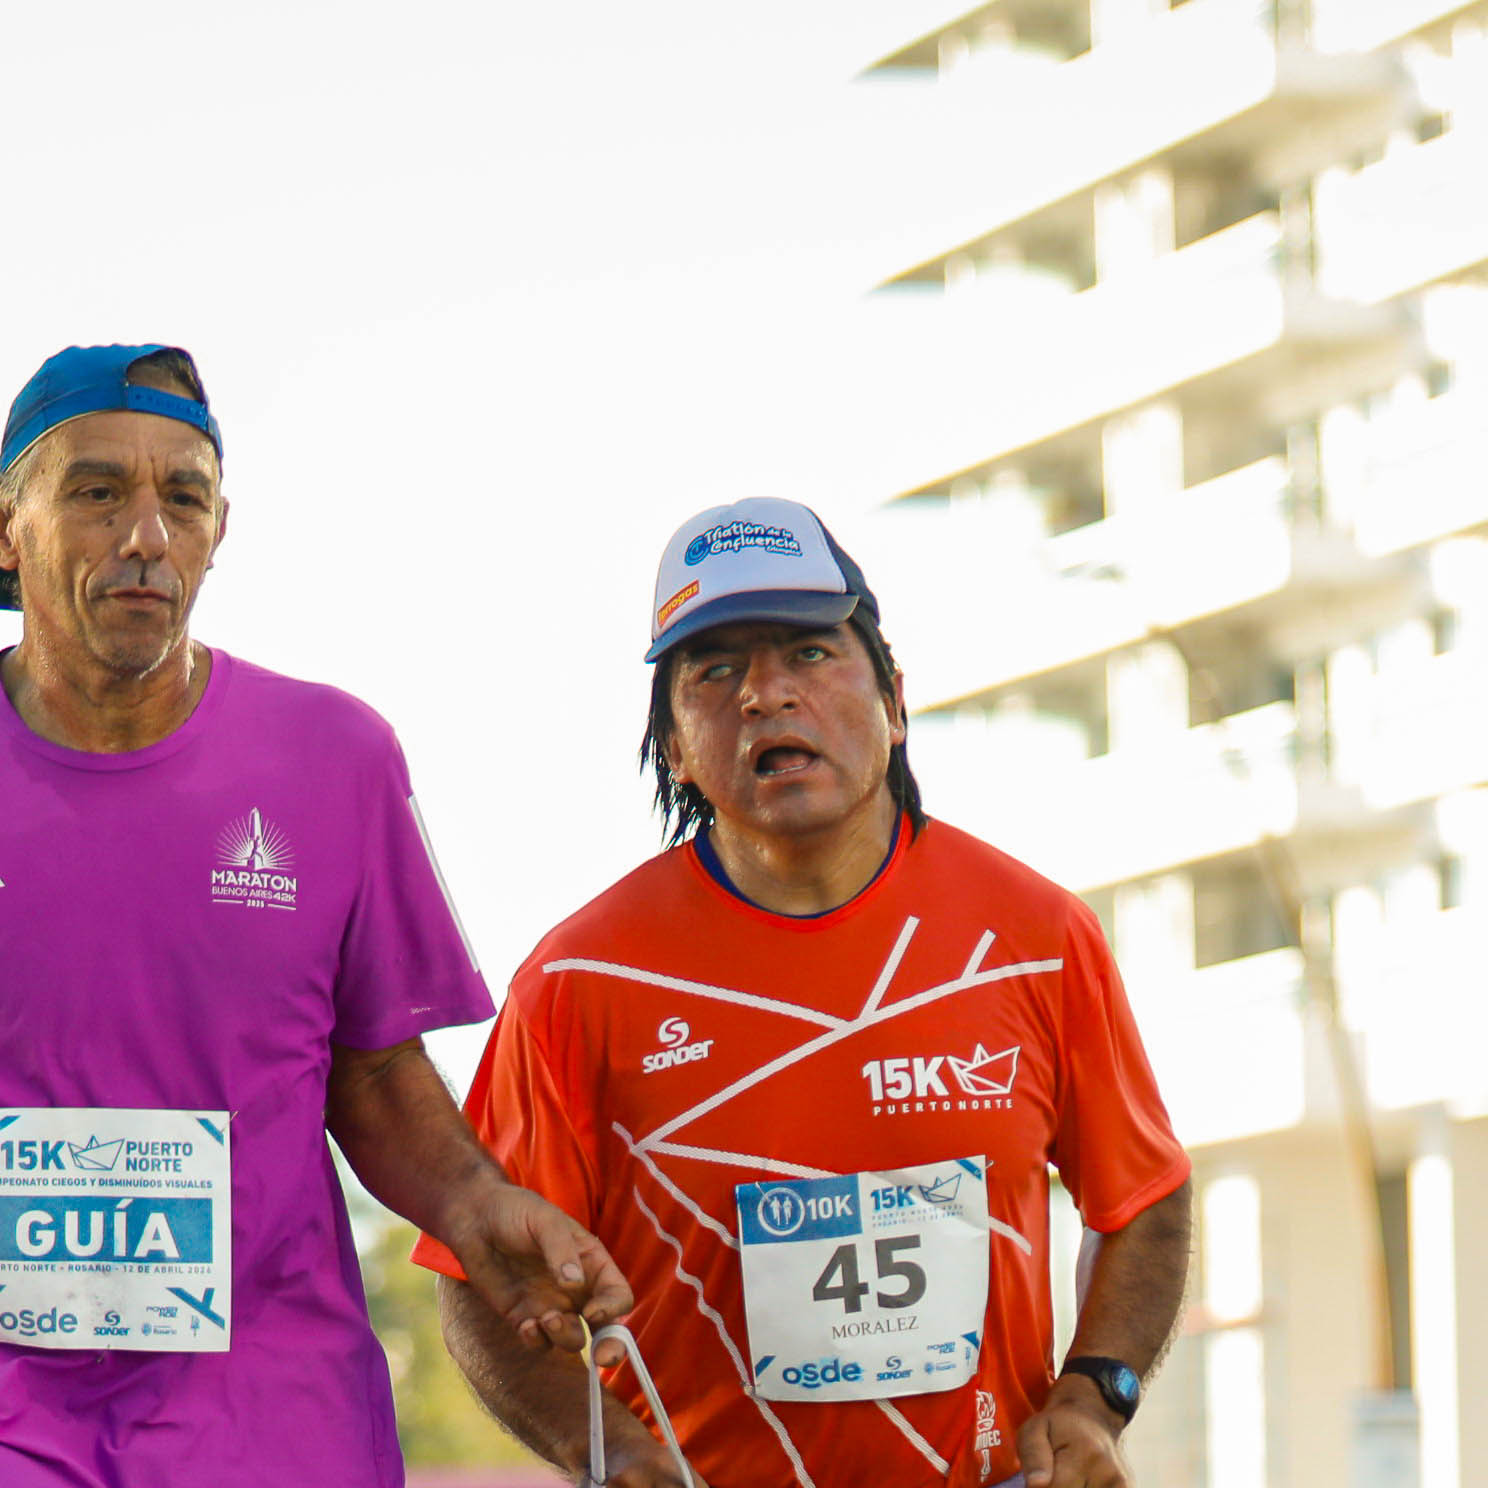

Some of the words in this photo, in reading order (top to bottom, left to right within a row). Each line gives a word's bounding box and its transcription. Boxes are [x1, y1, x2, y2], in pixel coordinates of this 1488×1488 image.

[212, 869, 297, 892] MARATON
[212, 886, 248, 897] BUENOS
[249, 889, 272, 899] AIRES
[862, 1057, 948, 1100] 15K
[873, 1101, 950, 1116] PUERTO
[958, 1099, 1012, 1111] NORTE
[0, 1140, 66, 1171] 15K
[126, 1141, 193, 1157] PUERTO
[126, 1158, 182, 1172] NORTE
[52, 1177, 87, 1186] CIEGOS
[89, 1178, 96, 1186] Y
[165, 1180, 213, 1189] VISUALES
[807, 1194, 853, 1221] 10K
[870, 1184, 916, 1211] 15K
[15, 1198, 180, 1258] GUÍA
[23, 1263, 56, 1272] NORTE
[68, 1264, 112, 1272] ROSARIO
[137, 1265, 150, 1273] DE
[154, 1265, 184, 1274] ABRIL
[813, 1234, 927, 1314] 45
[0, 1307, 78, 1335] osde
[831, 1316, 919, 1340] MORALEZ
[782, 1358, 862, 1386] osde
